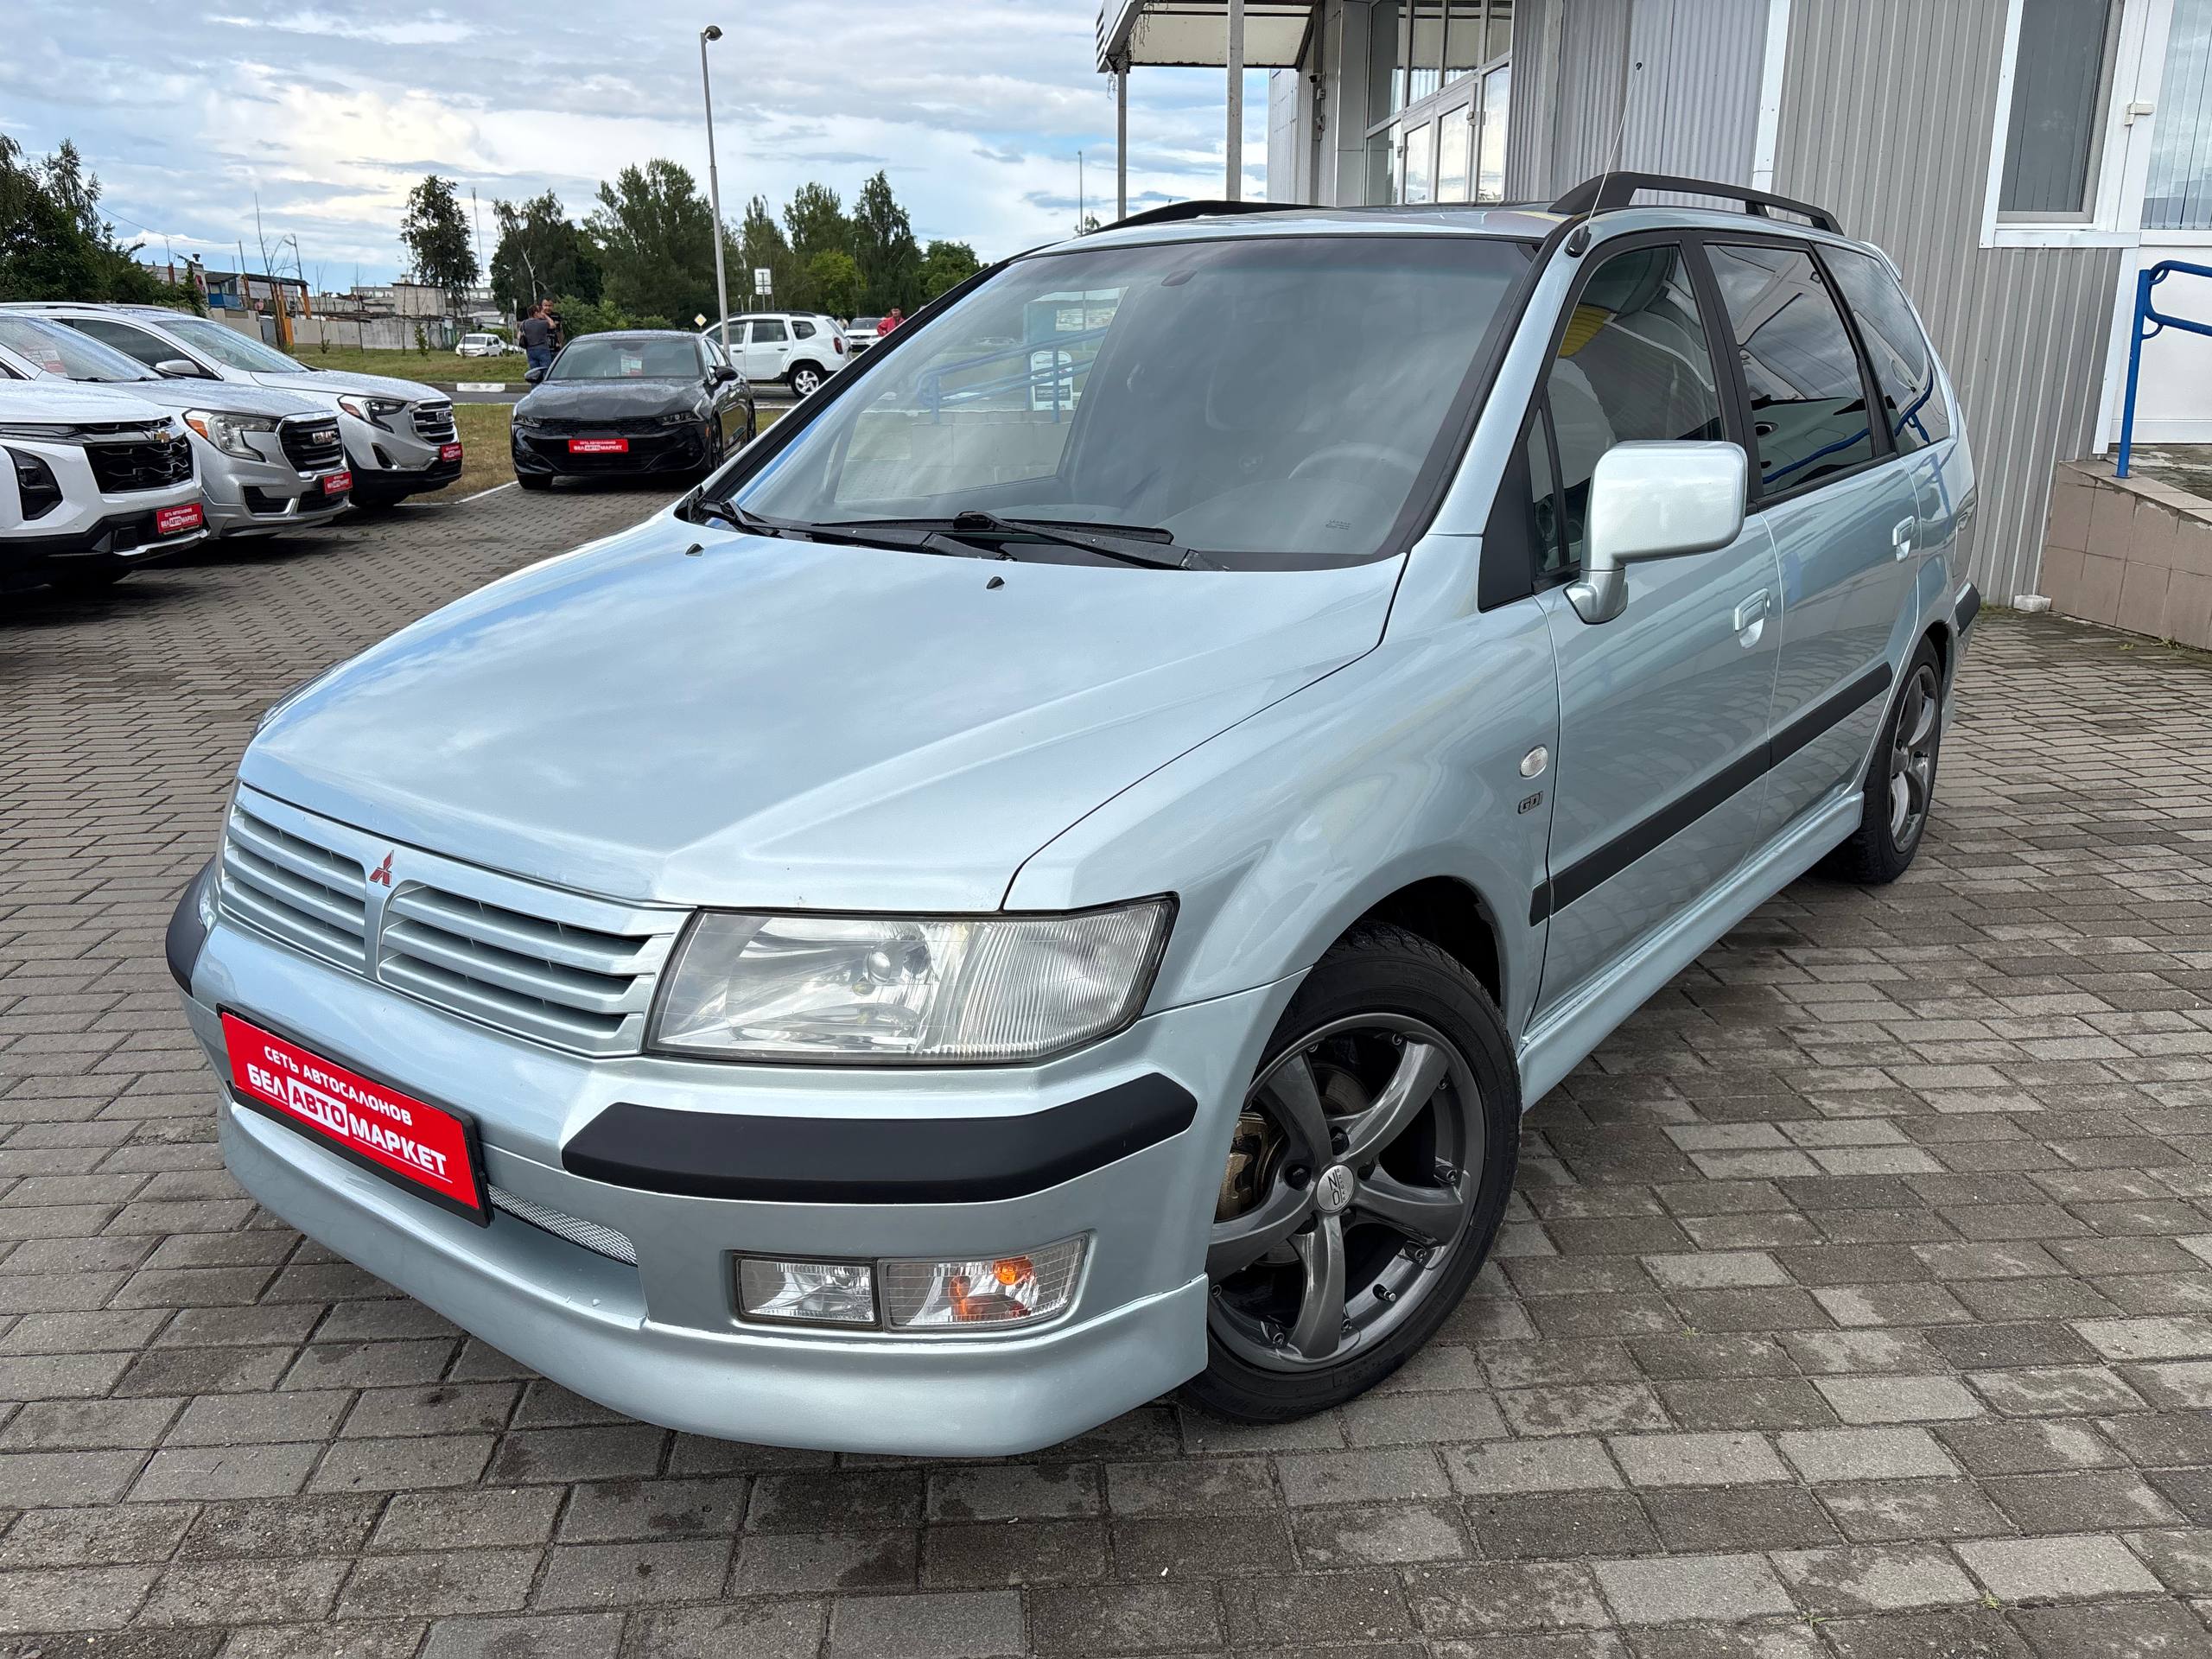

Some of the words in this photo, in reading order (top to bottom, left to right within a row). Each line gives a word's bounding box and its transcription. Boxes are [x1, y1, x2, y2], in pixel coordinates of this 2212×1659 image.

[312, 430, 338, 444] GMC
[1518, 791, 1543, 814] GDI
[264, 1046, 300, 1074] СЕТЬ
[303, 1065, 413, 1127] АВТОСАЛОНОВ
